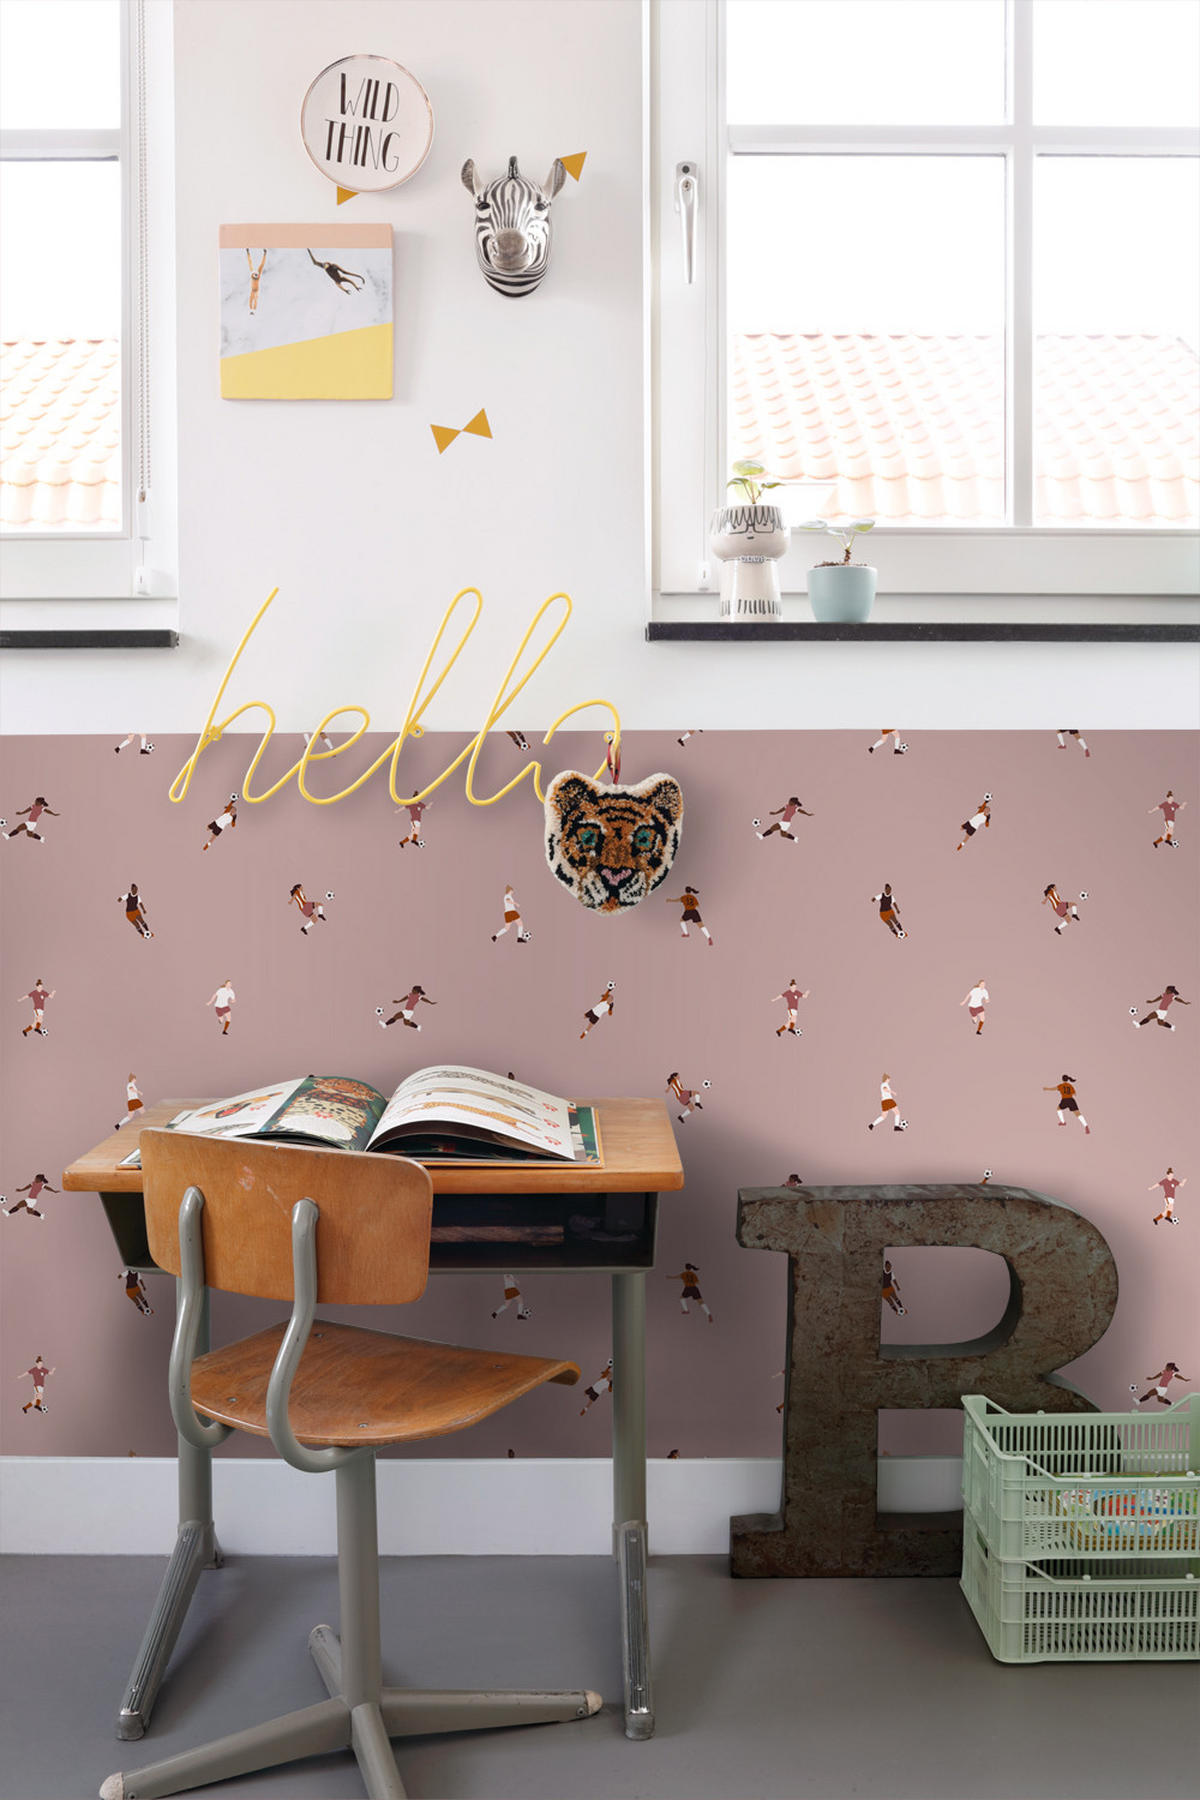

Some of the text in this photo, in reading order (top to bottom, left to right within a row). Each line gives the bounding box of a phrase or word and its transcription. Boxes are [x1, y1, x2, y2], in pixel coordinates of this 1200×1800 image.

[340, 73, 400, 122] WILD
[325, 119, 401, 173] THING
[730, 1184, 1119, 1578] R
